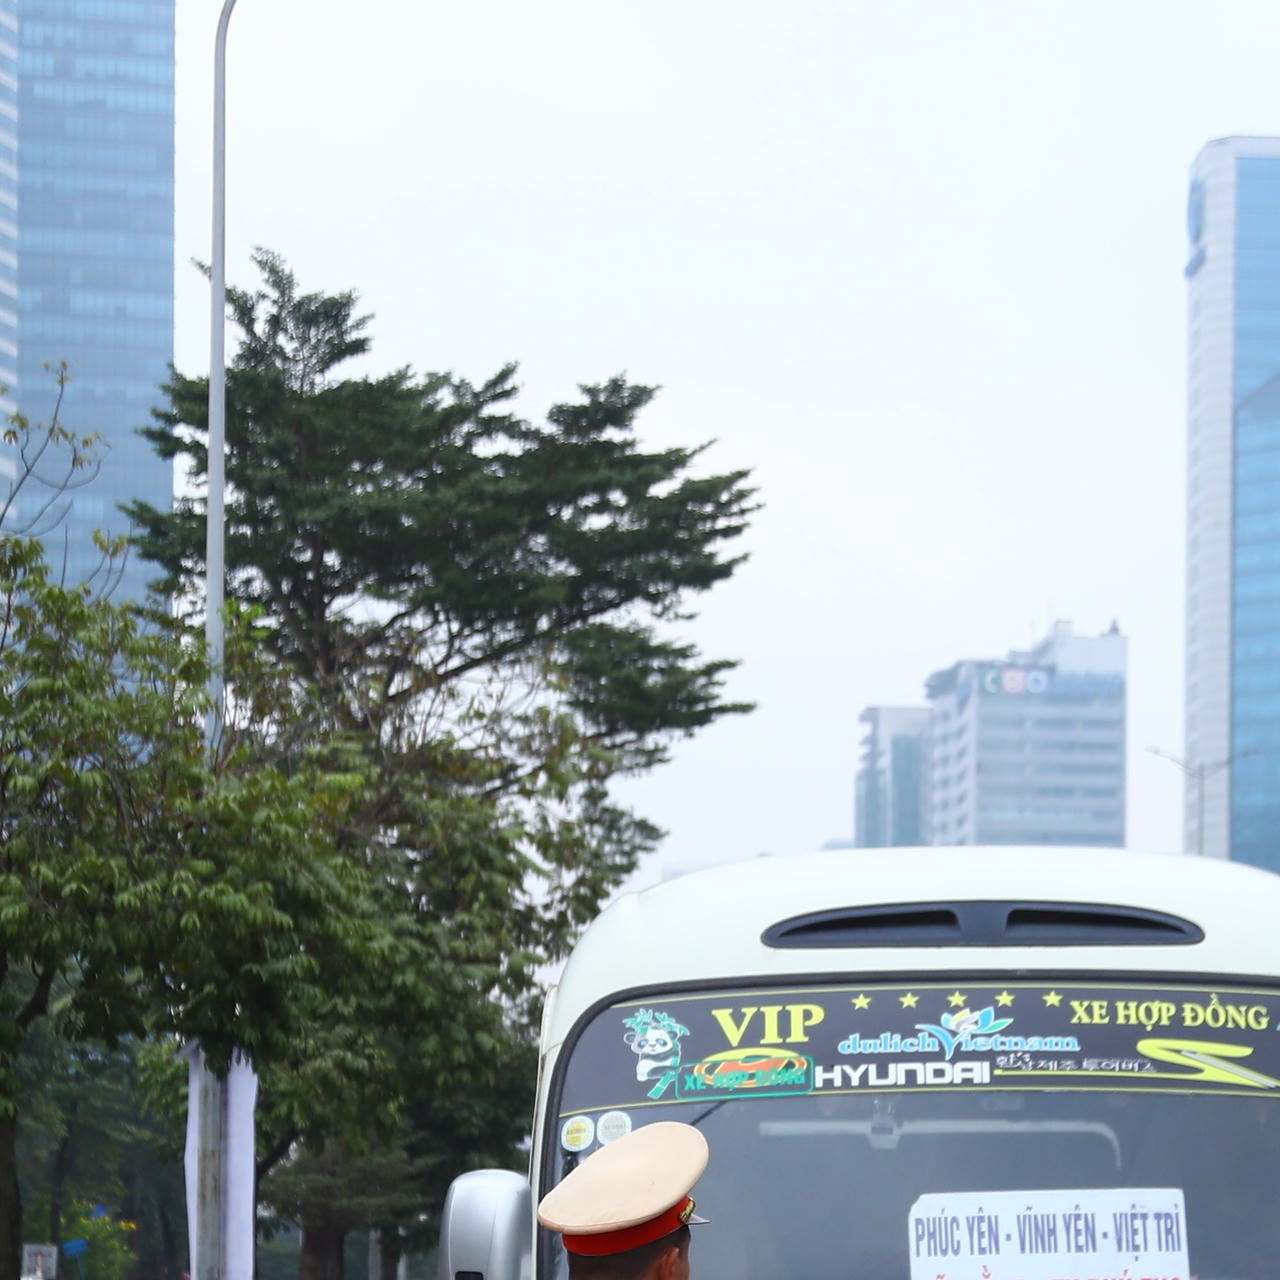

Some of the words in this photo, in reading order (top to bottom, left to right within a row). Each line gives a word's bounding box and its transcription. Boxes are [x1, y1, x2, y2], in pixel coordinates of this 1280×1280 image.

[711, 1004, 825, 1047] VIP
[1070, 1000, 1110, 1025] XE
[1115, 1000, 1177, 1032] HỢP
[1182, 992, 1270, 1031] ĐỒNG
[815, 1061, 990, 1088] HYUNDAI
[914, 1207, 960, 1258] PHÚC
[965, 1206, 1000, 1256] YÊN
[1016, 1206, 1058, 1254] VĨNH
[1062, 1204, 1097, 1253] YÊN
[1112, 1203, 1149, 1262] VIỆT
